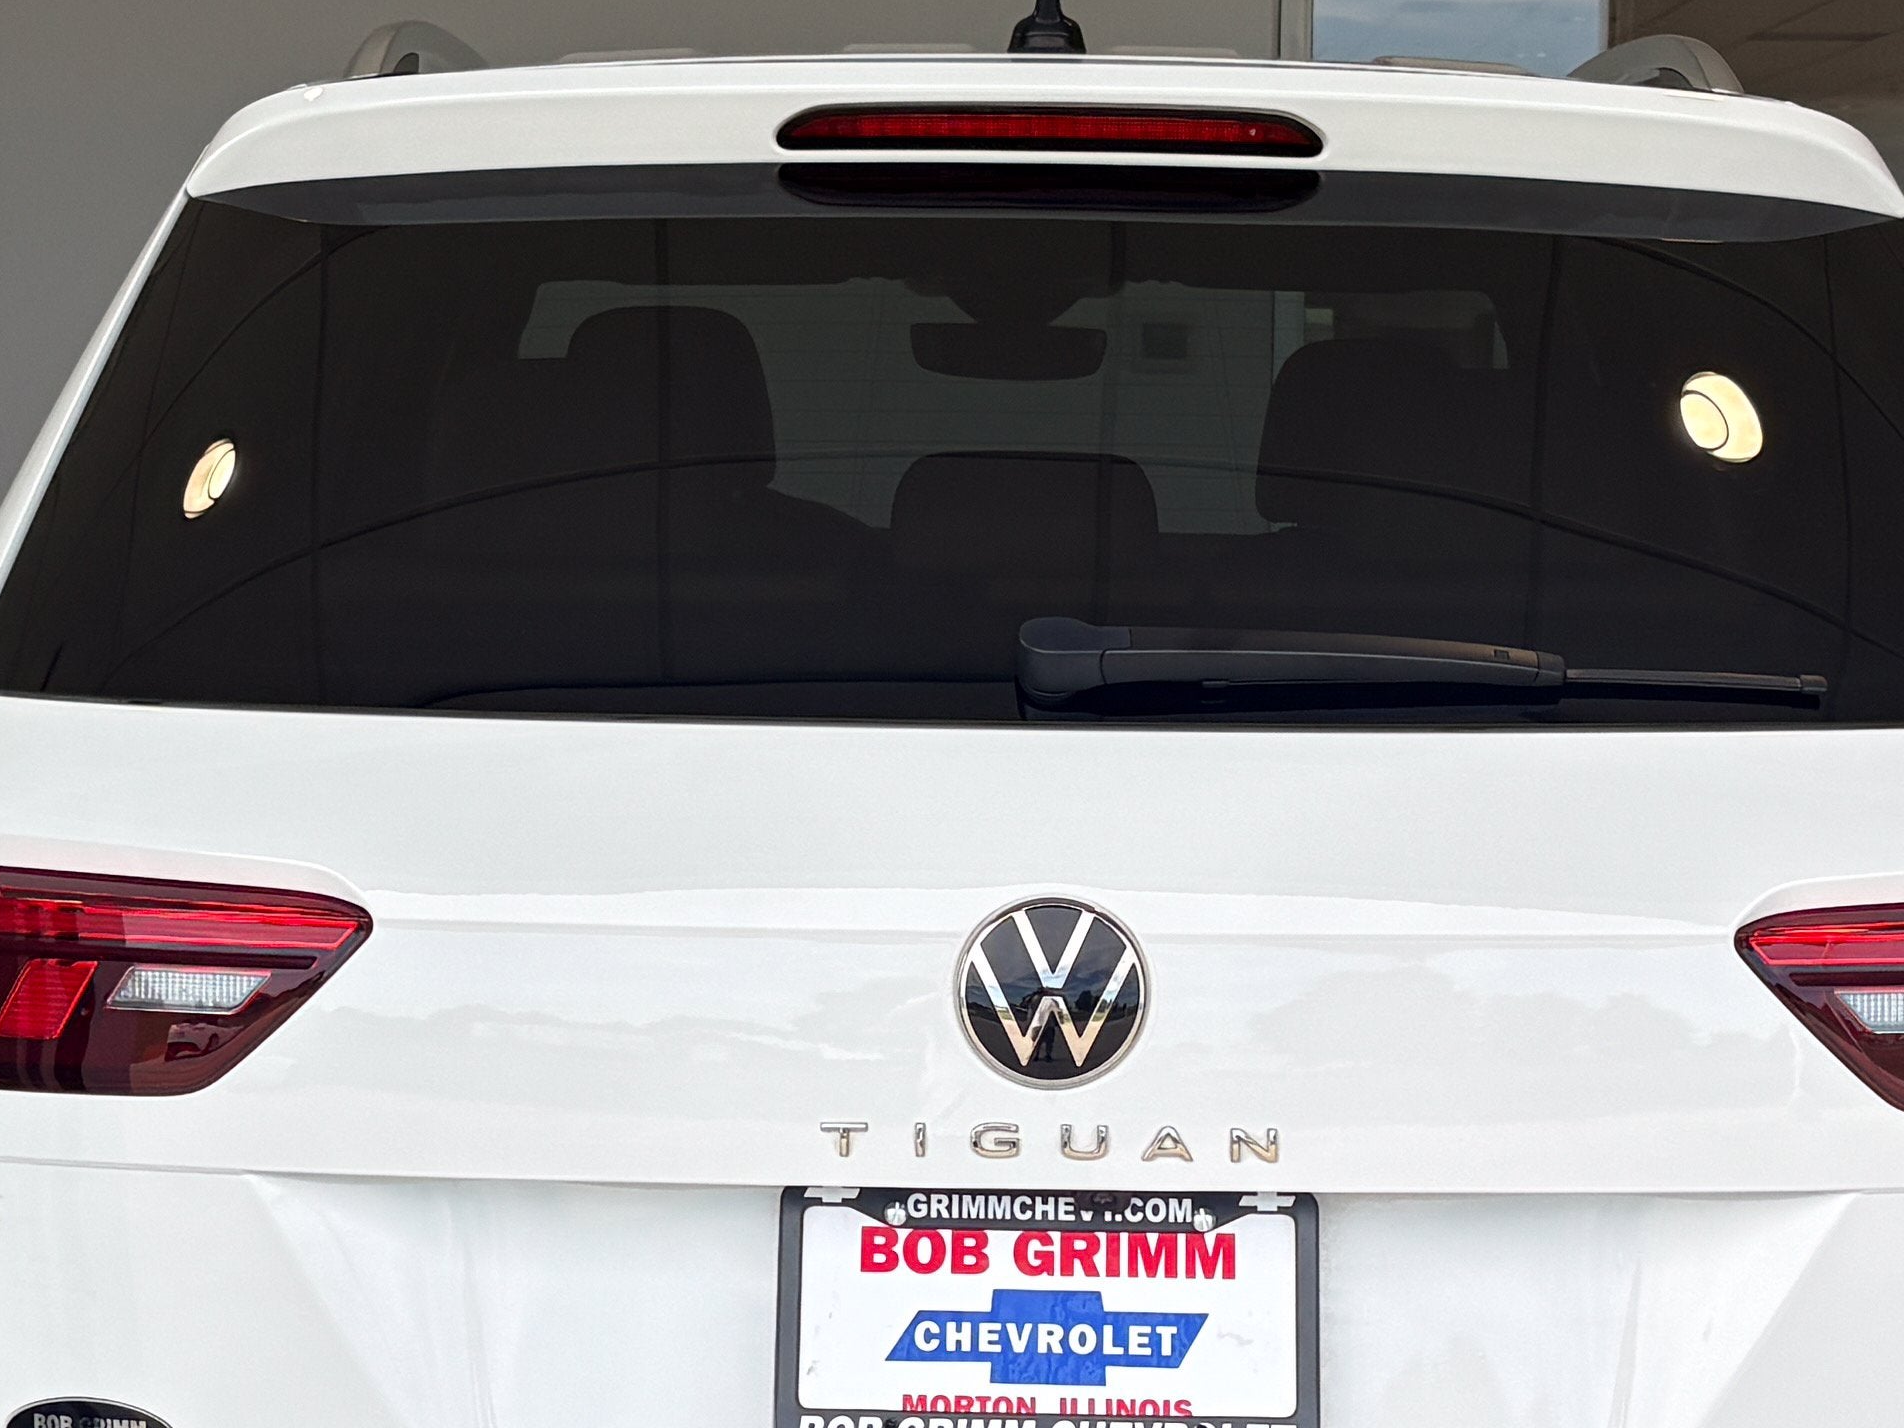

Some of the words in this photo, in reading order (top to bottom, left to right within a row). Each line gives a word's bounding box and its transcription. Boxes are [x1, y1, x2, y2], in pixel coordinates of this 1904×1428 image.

[959, 904, 1144, 1074] VW
[819, 1121, 1279, 1164] TIGUAN
[860, 1225, 989, 1276] BOB
[1012, 1230, 1236, 1281] GRIMM
[912, 1320, 1180, 1357] CHEVROLET
